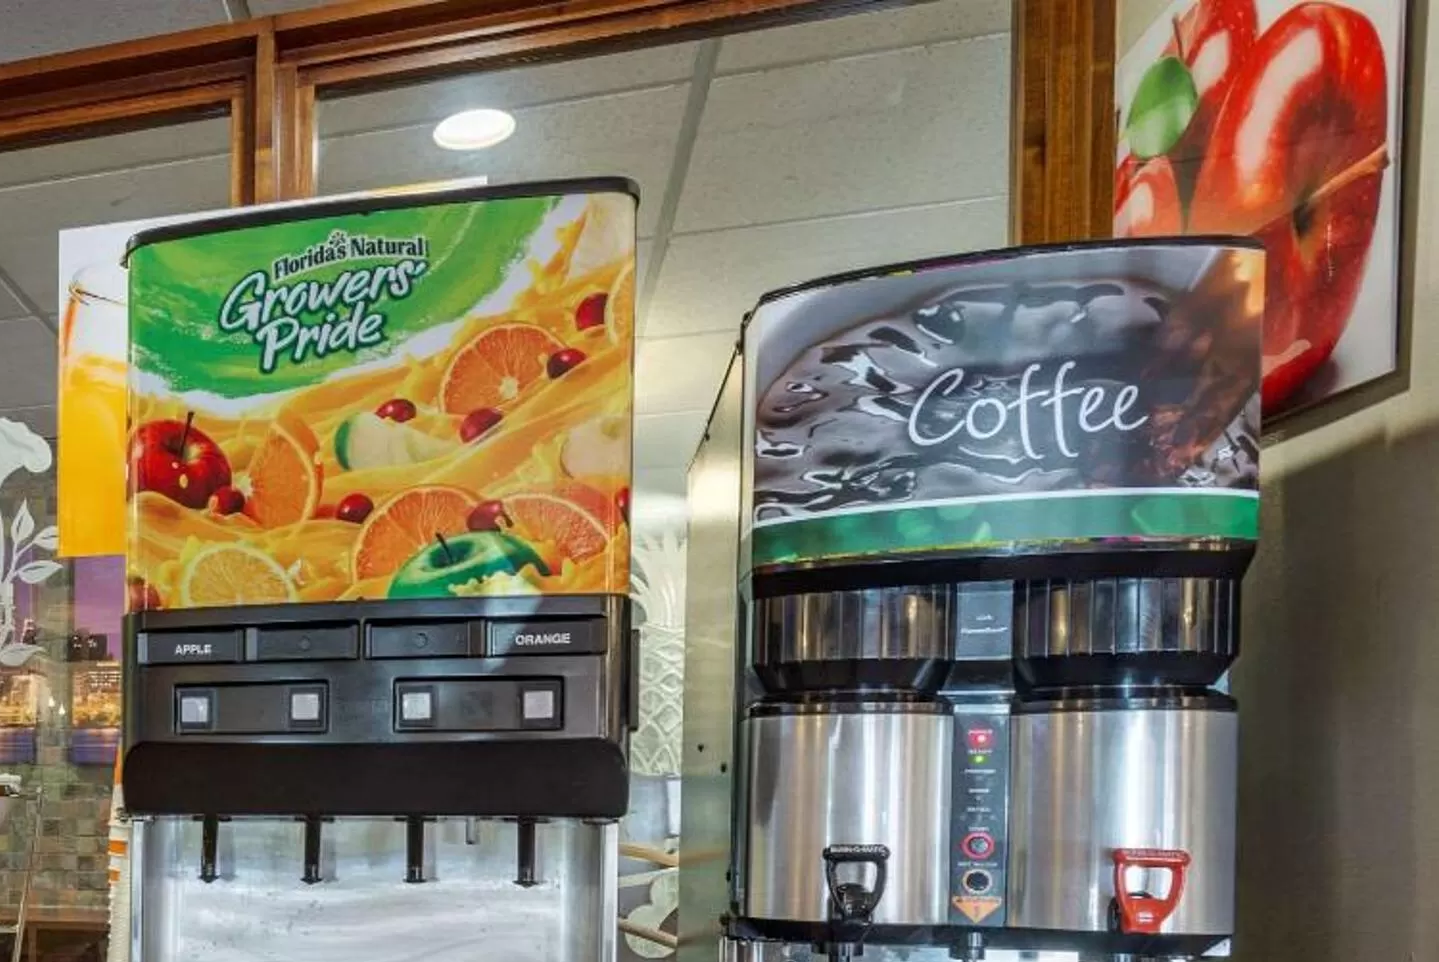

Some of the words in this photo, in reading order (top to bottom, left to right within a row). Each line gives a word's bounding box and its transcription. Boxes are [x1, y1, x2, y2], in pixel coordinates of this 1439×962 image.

[349, 236, 424, 258] Natural
[257, 300, 384, 373] Pride
[907, 360, 1149, 461] Coffee
[174, 643, 213, 656] APPLE
[514, 631, 572, 647] ORANGE
